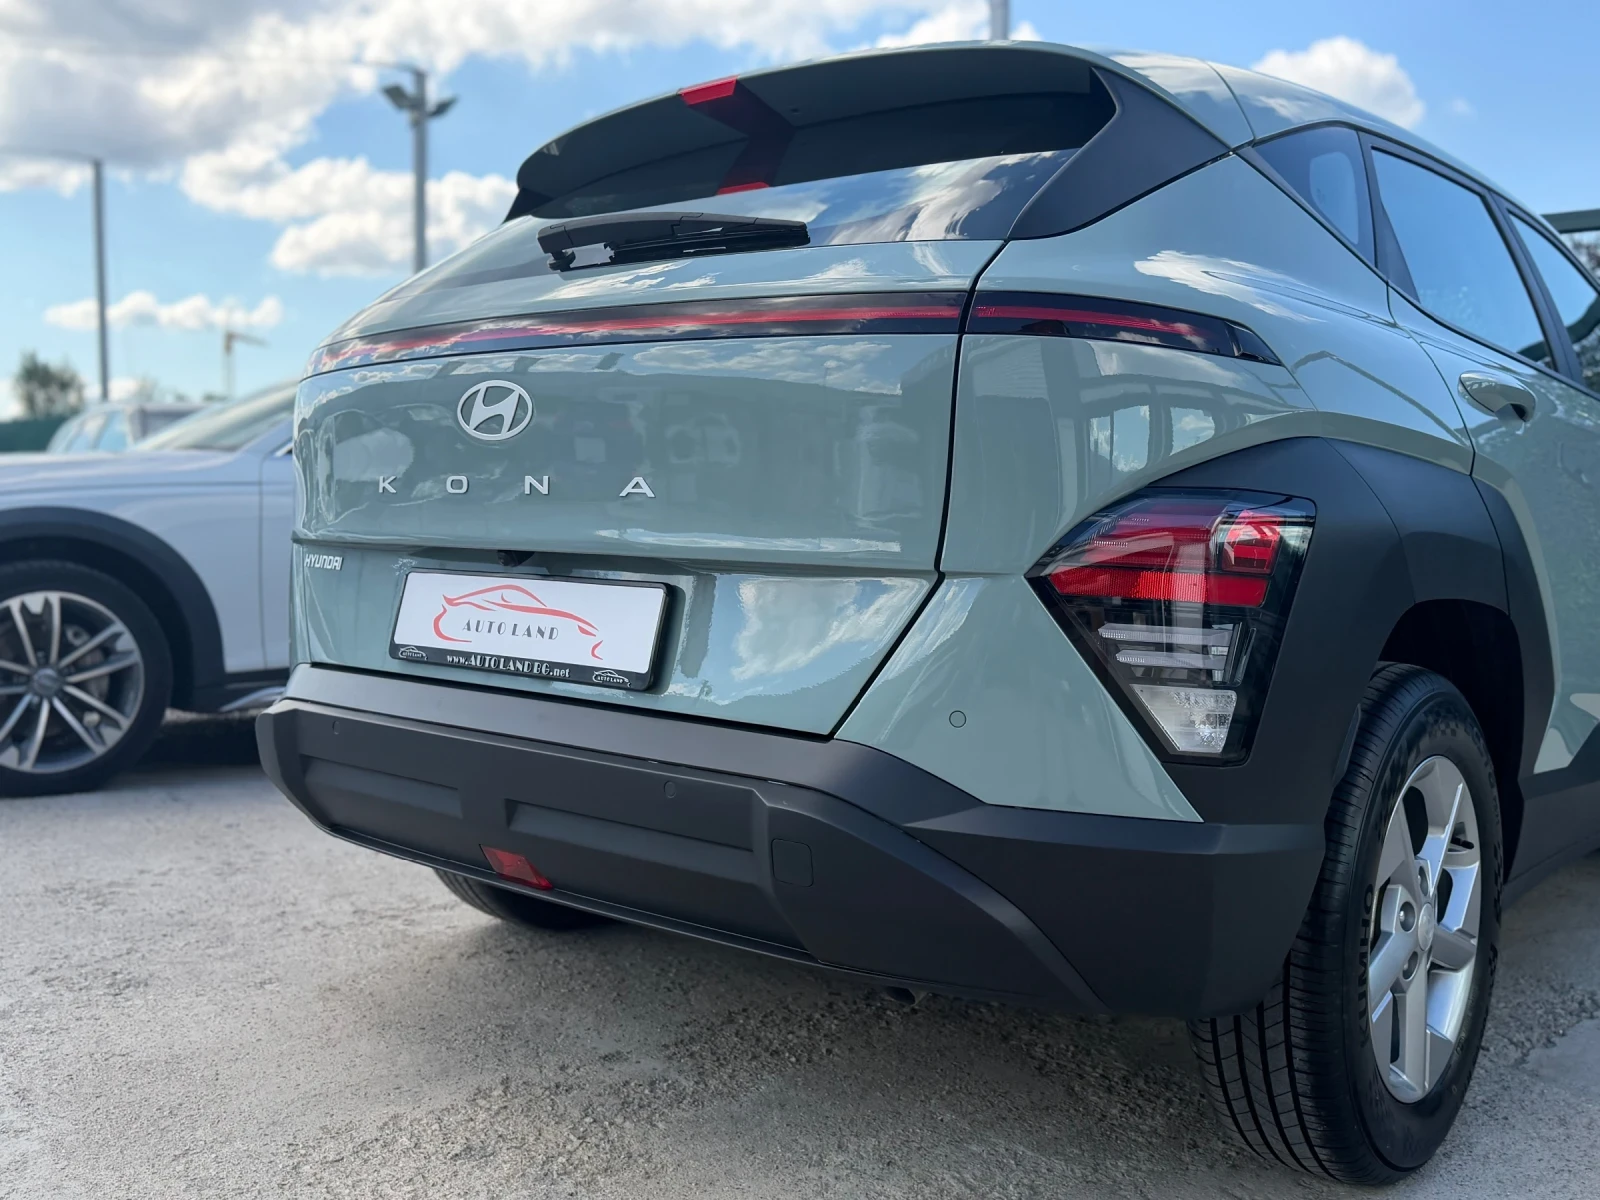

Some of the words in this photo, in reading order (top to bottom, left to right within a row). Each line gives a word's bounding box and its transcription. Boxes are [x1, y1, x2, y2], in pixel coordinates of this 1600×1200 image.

[378, 475, 655, 497] KONA
[304, 554, 343, 570] HYUNDAI
[1357, 883, 1374, 1049] KUMHO
